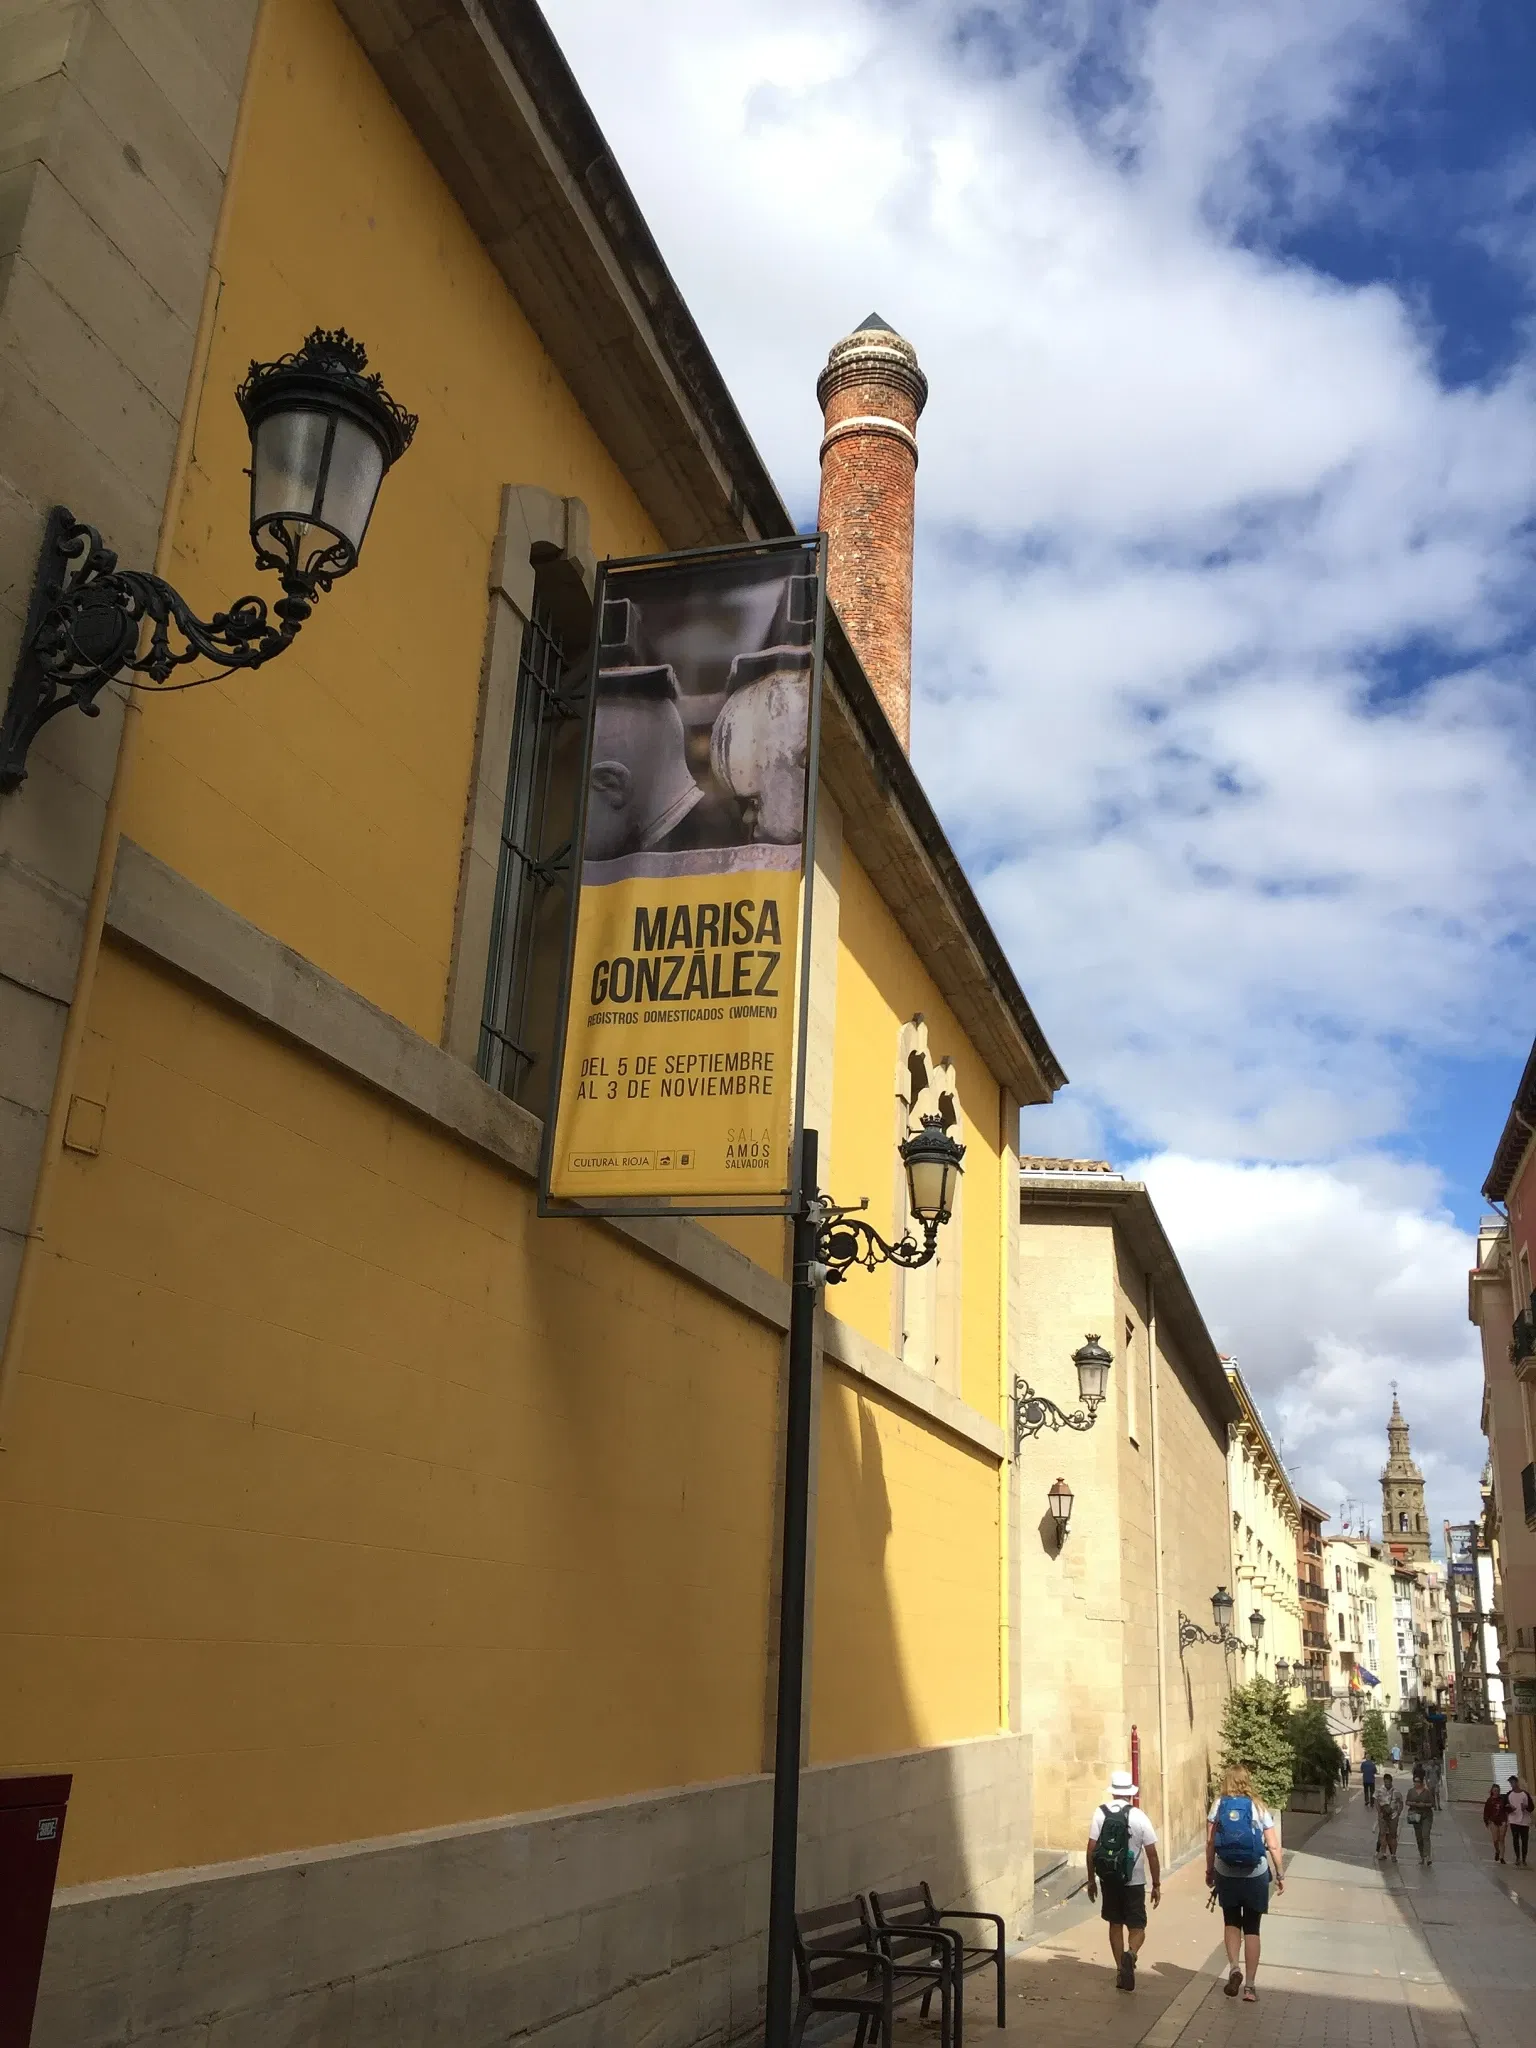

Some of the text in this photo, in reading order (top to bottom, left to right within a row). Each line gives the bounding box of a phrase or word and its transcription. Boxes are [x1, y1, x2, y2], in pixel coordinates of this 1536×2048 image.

[633, 899, 782, 951] MARISA
[590, 949, 781, 1005] GONZÁLEZ
[587, 1005, 777, 1028] REGISTROS DOMESTICADOS (WOMEN)
[580, 1051, 774, 1078] DEL 5 DE SEPTIEMBRE
[577, 1075, 773, 1100] AL 3 DE NOVIEMBRE
[727, 1128, 771, 1143] SALA
[726, 1141, 770, 1158] AMÓS
[573, 1156, 650, 1168] CULTURAL RIOJA
[725, 1158, 769, 1169] SALVADOR
